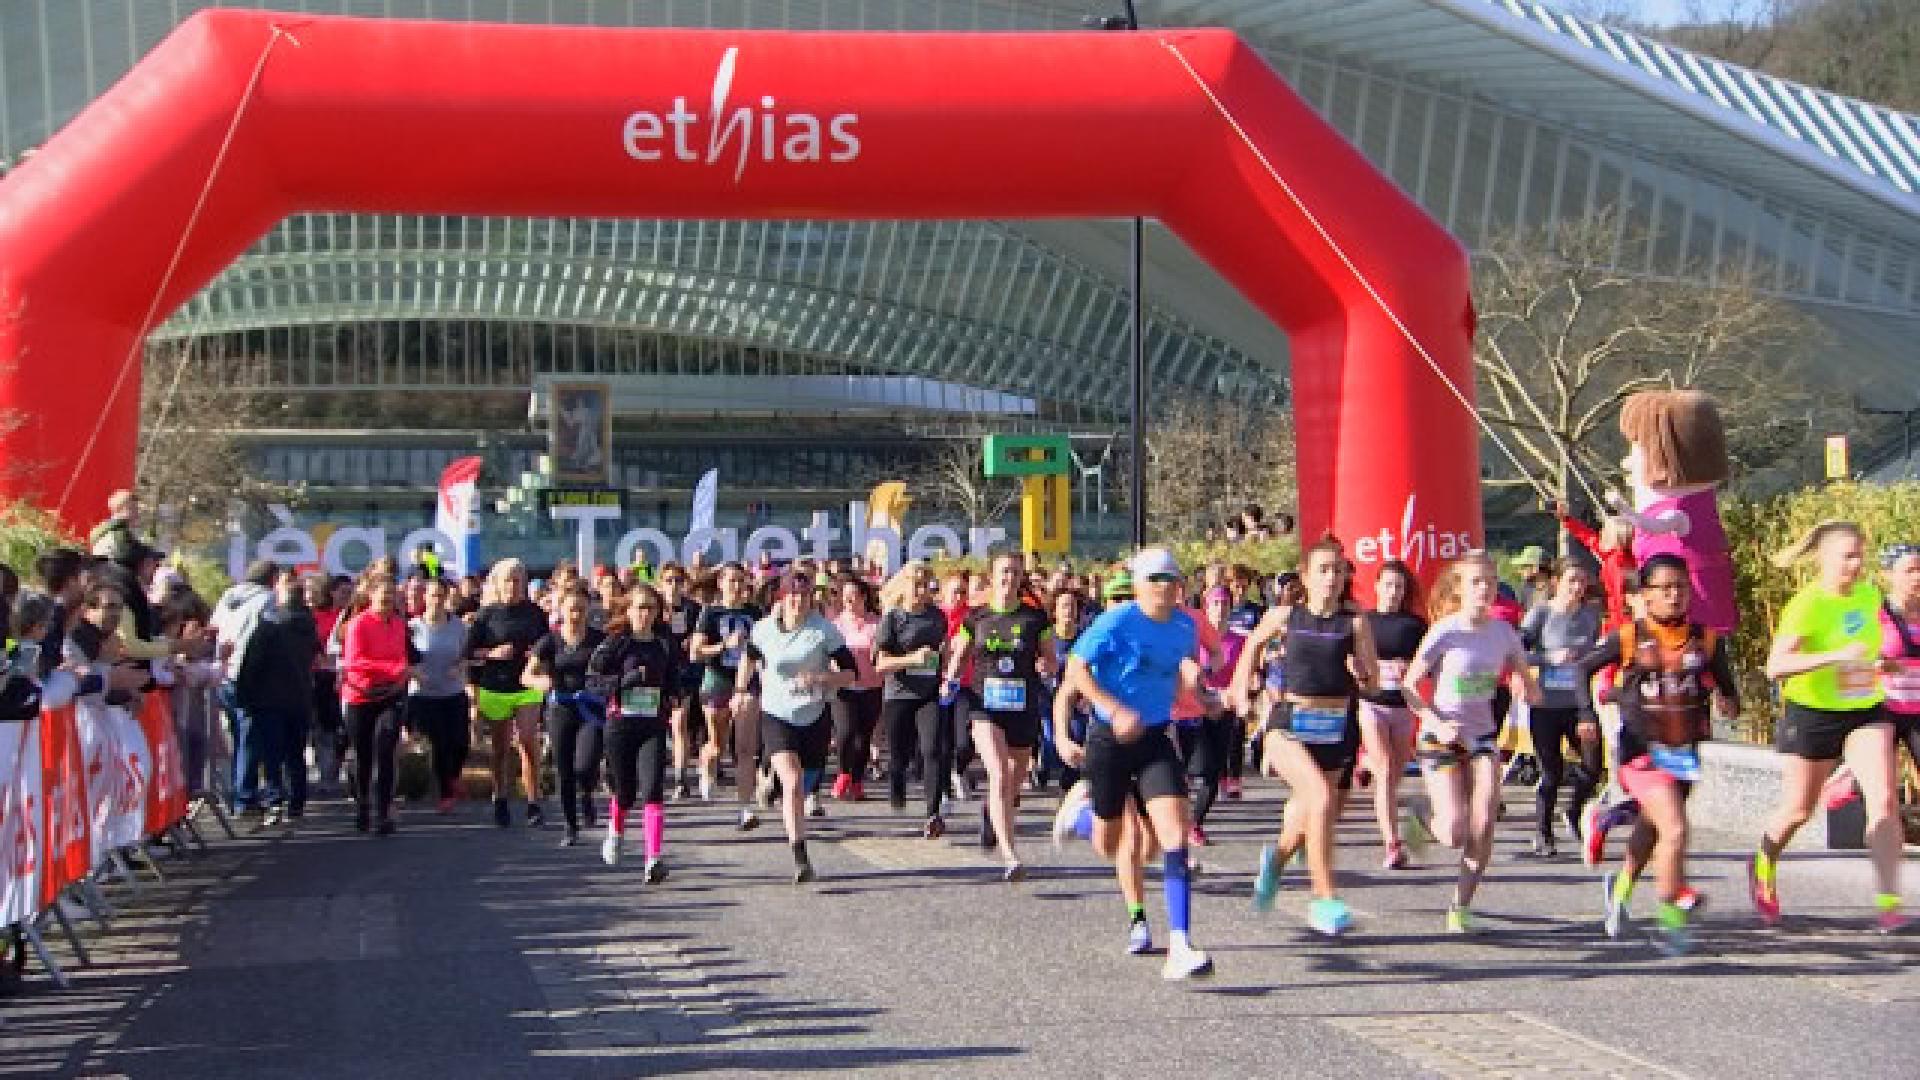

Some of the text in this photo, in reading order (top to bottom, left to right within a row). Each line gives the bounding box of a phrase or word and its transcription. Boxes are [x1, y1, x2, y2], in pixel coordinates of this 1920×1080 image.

[623, 47, 861, 184] ethias
[549, 505, 1006, 585] Together
[1354, 493, 1471, 573] ethias
